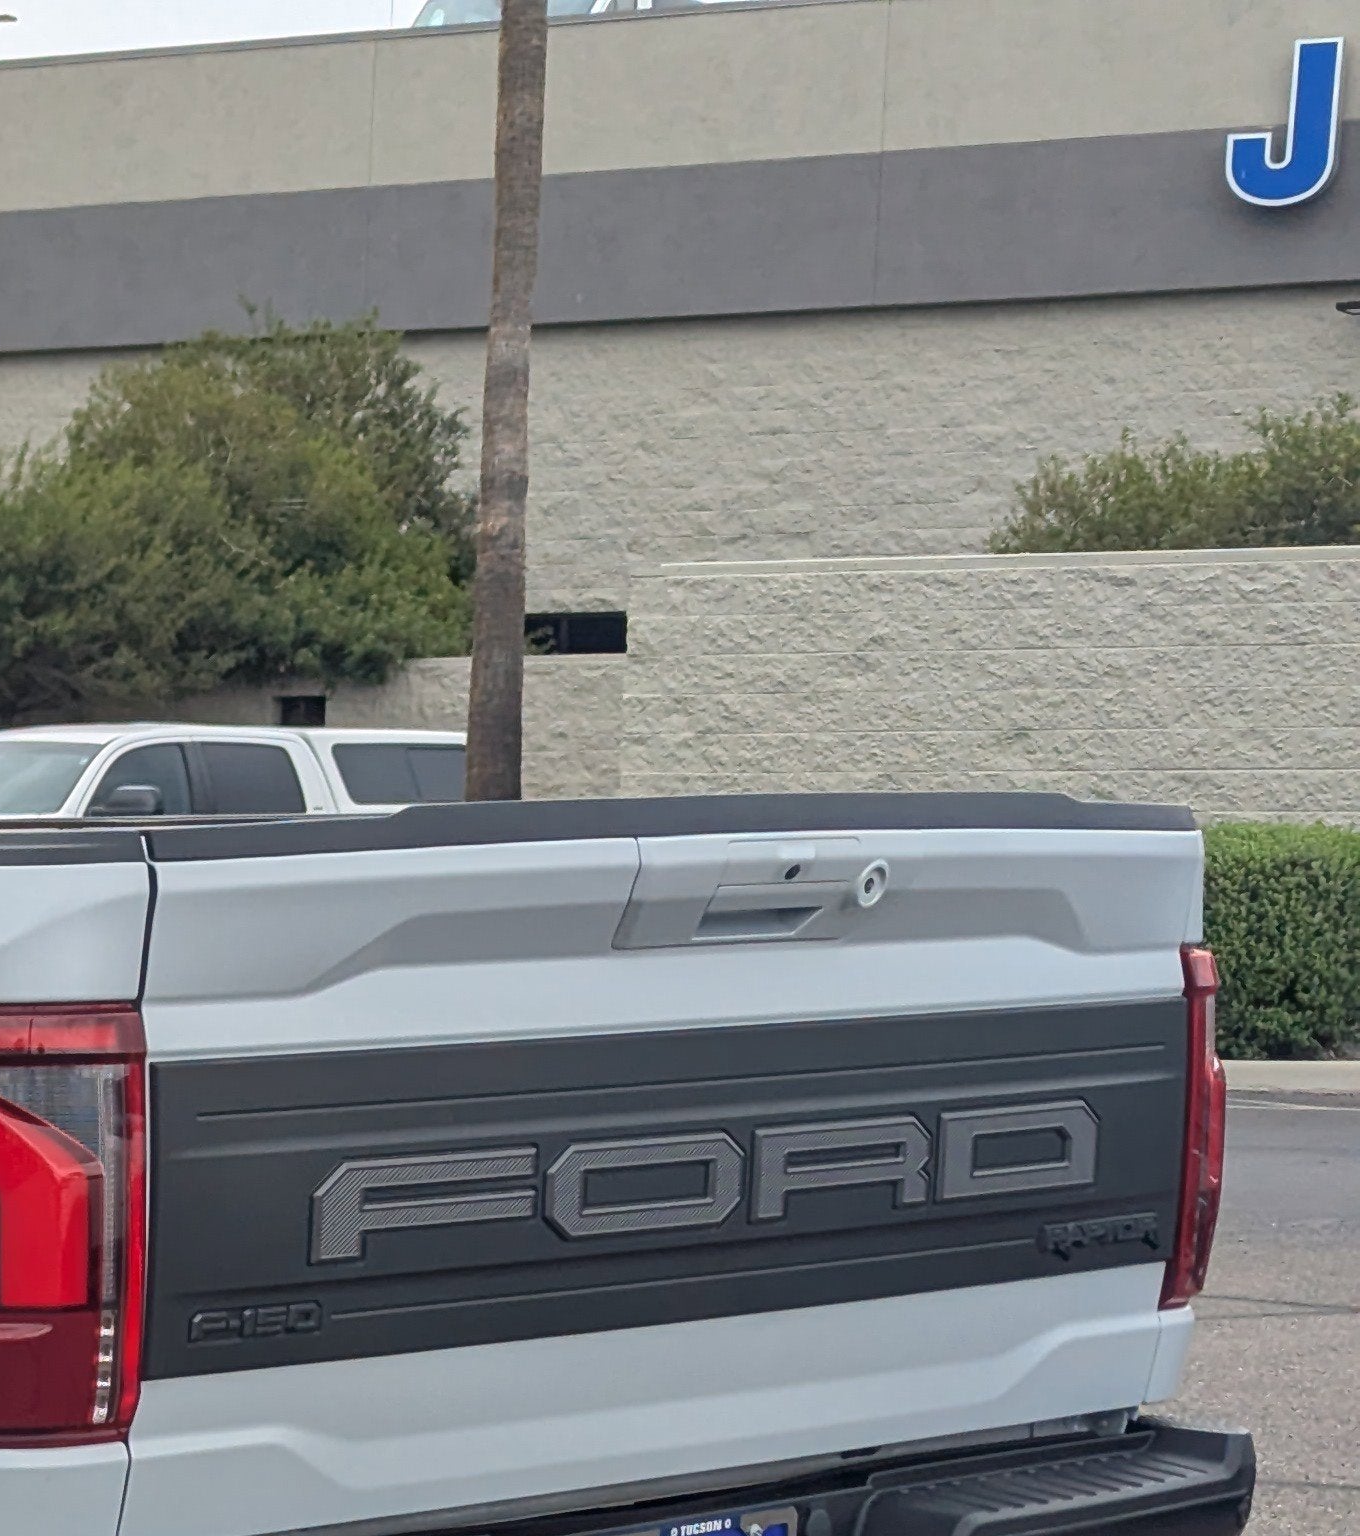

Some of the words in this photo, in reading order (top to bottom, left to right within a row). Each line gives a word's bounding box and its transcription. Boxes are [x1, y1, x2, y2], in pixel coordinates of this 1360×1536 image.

[1224, 35, 1345, 208] J
[311, 1098, 1100, 1263] FORD
[1038, 1211, 1160, 1260] RAPTOR
[187, 1300, 321, 1344] F-150
[680, 1520, 722, 1536] TUCSON
